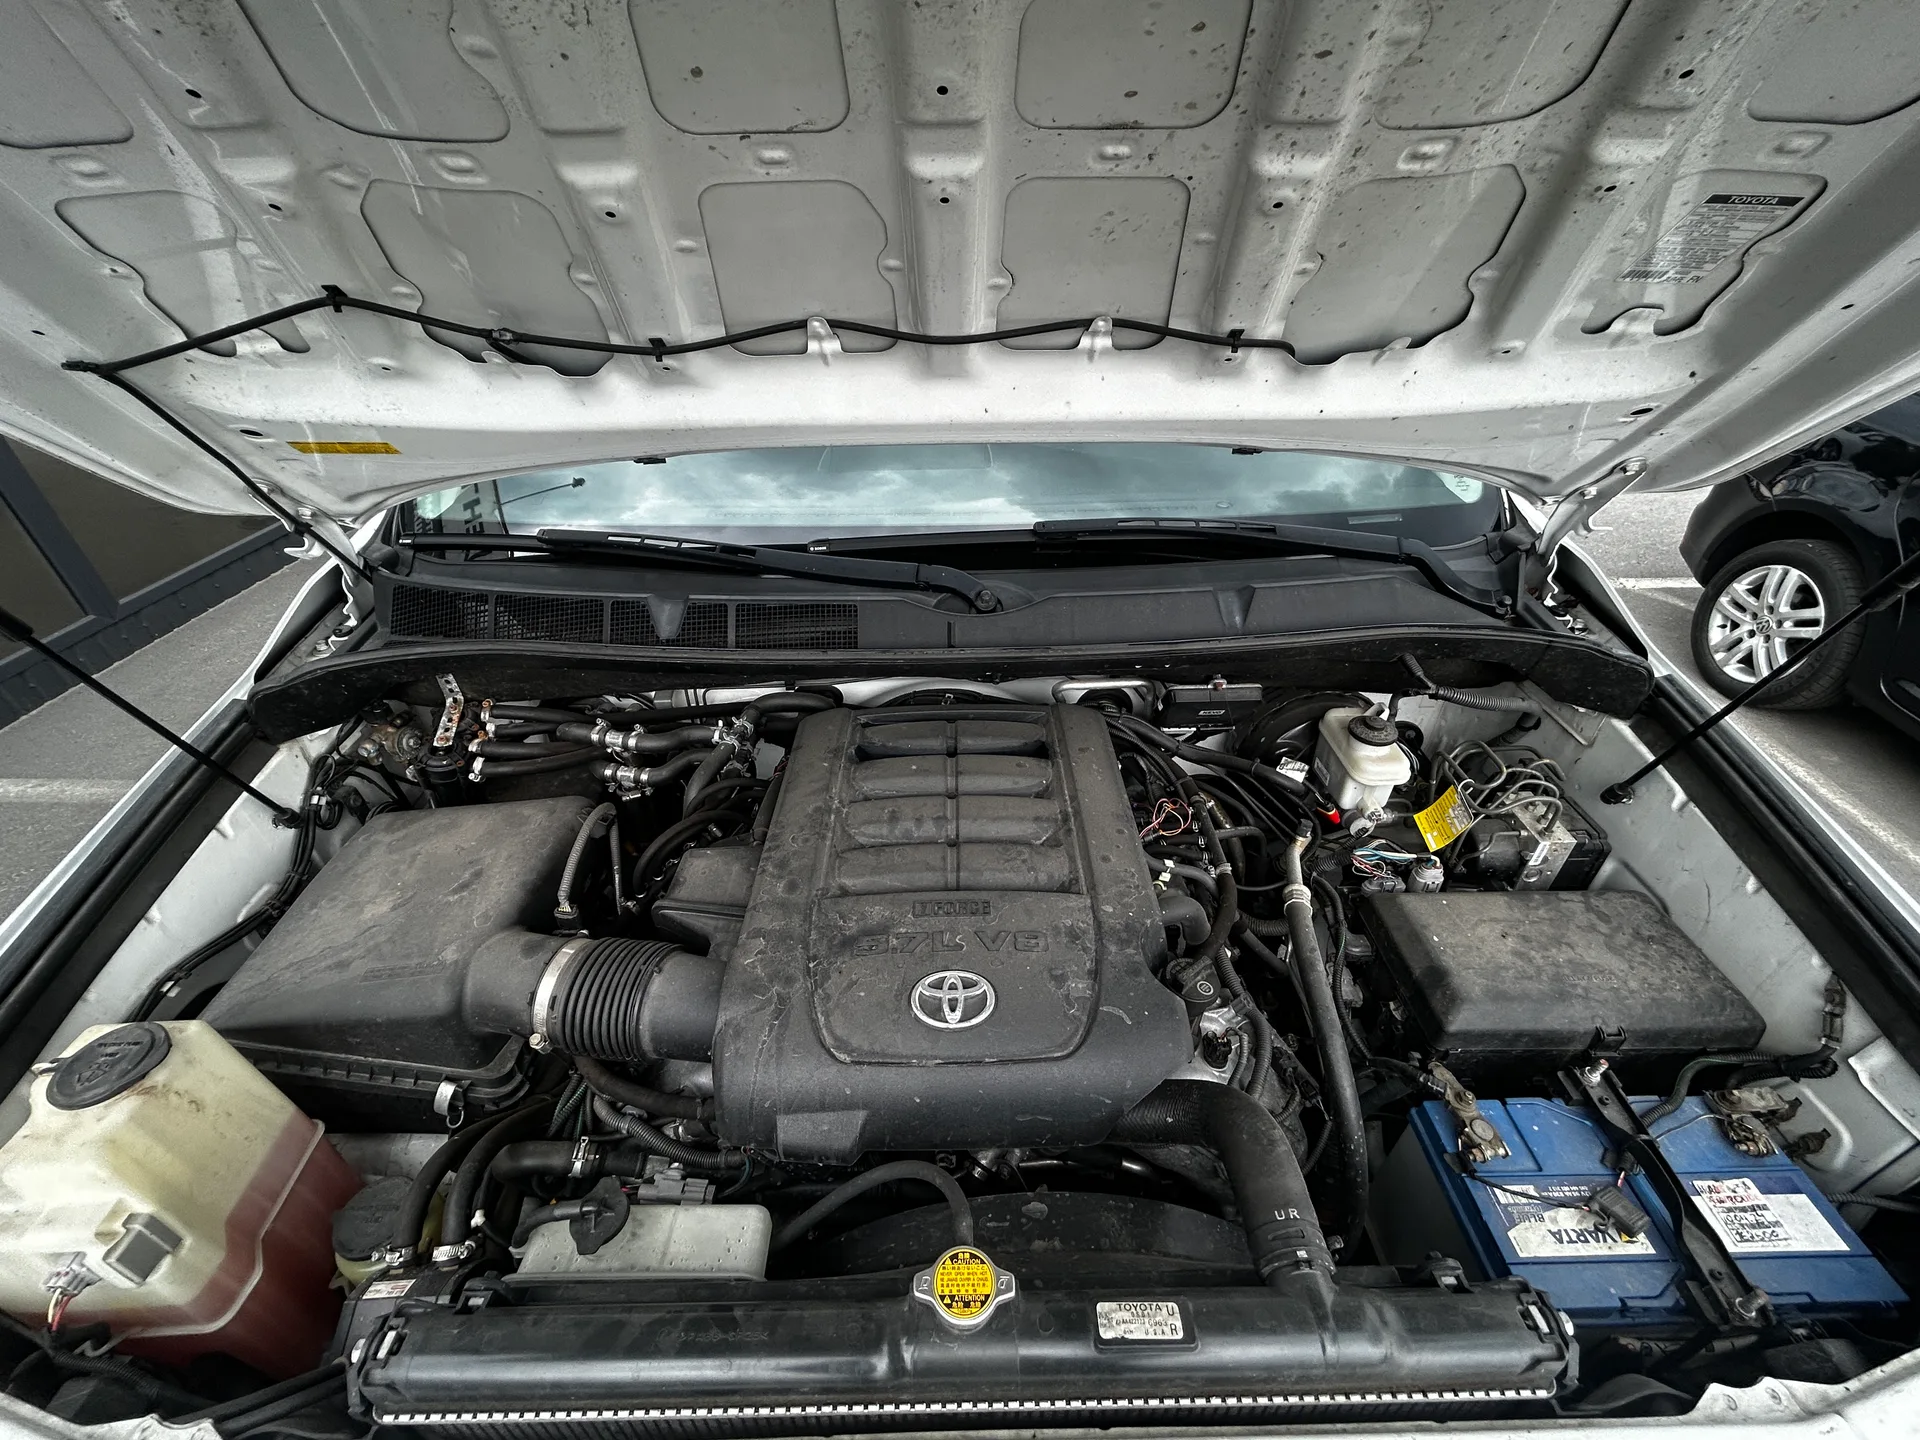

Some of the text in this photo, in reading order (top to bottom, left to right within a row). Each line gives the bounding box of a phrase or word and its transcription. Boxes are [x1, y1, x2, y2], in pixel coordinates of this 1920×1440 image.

[1728, 195, 1779, 205] TOYOTA
[974, 930, 1049, 952] V8
[1547, 1228, 1618, 1245] VARTA
[954, 1294, 985, 1302] ATTENTION
[1116, 1303, 1162, 1312] TOYOTA
